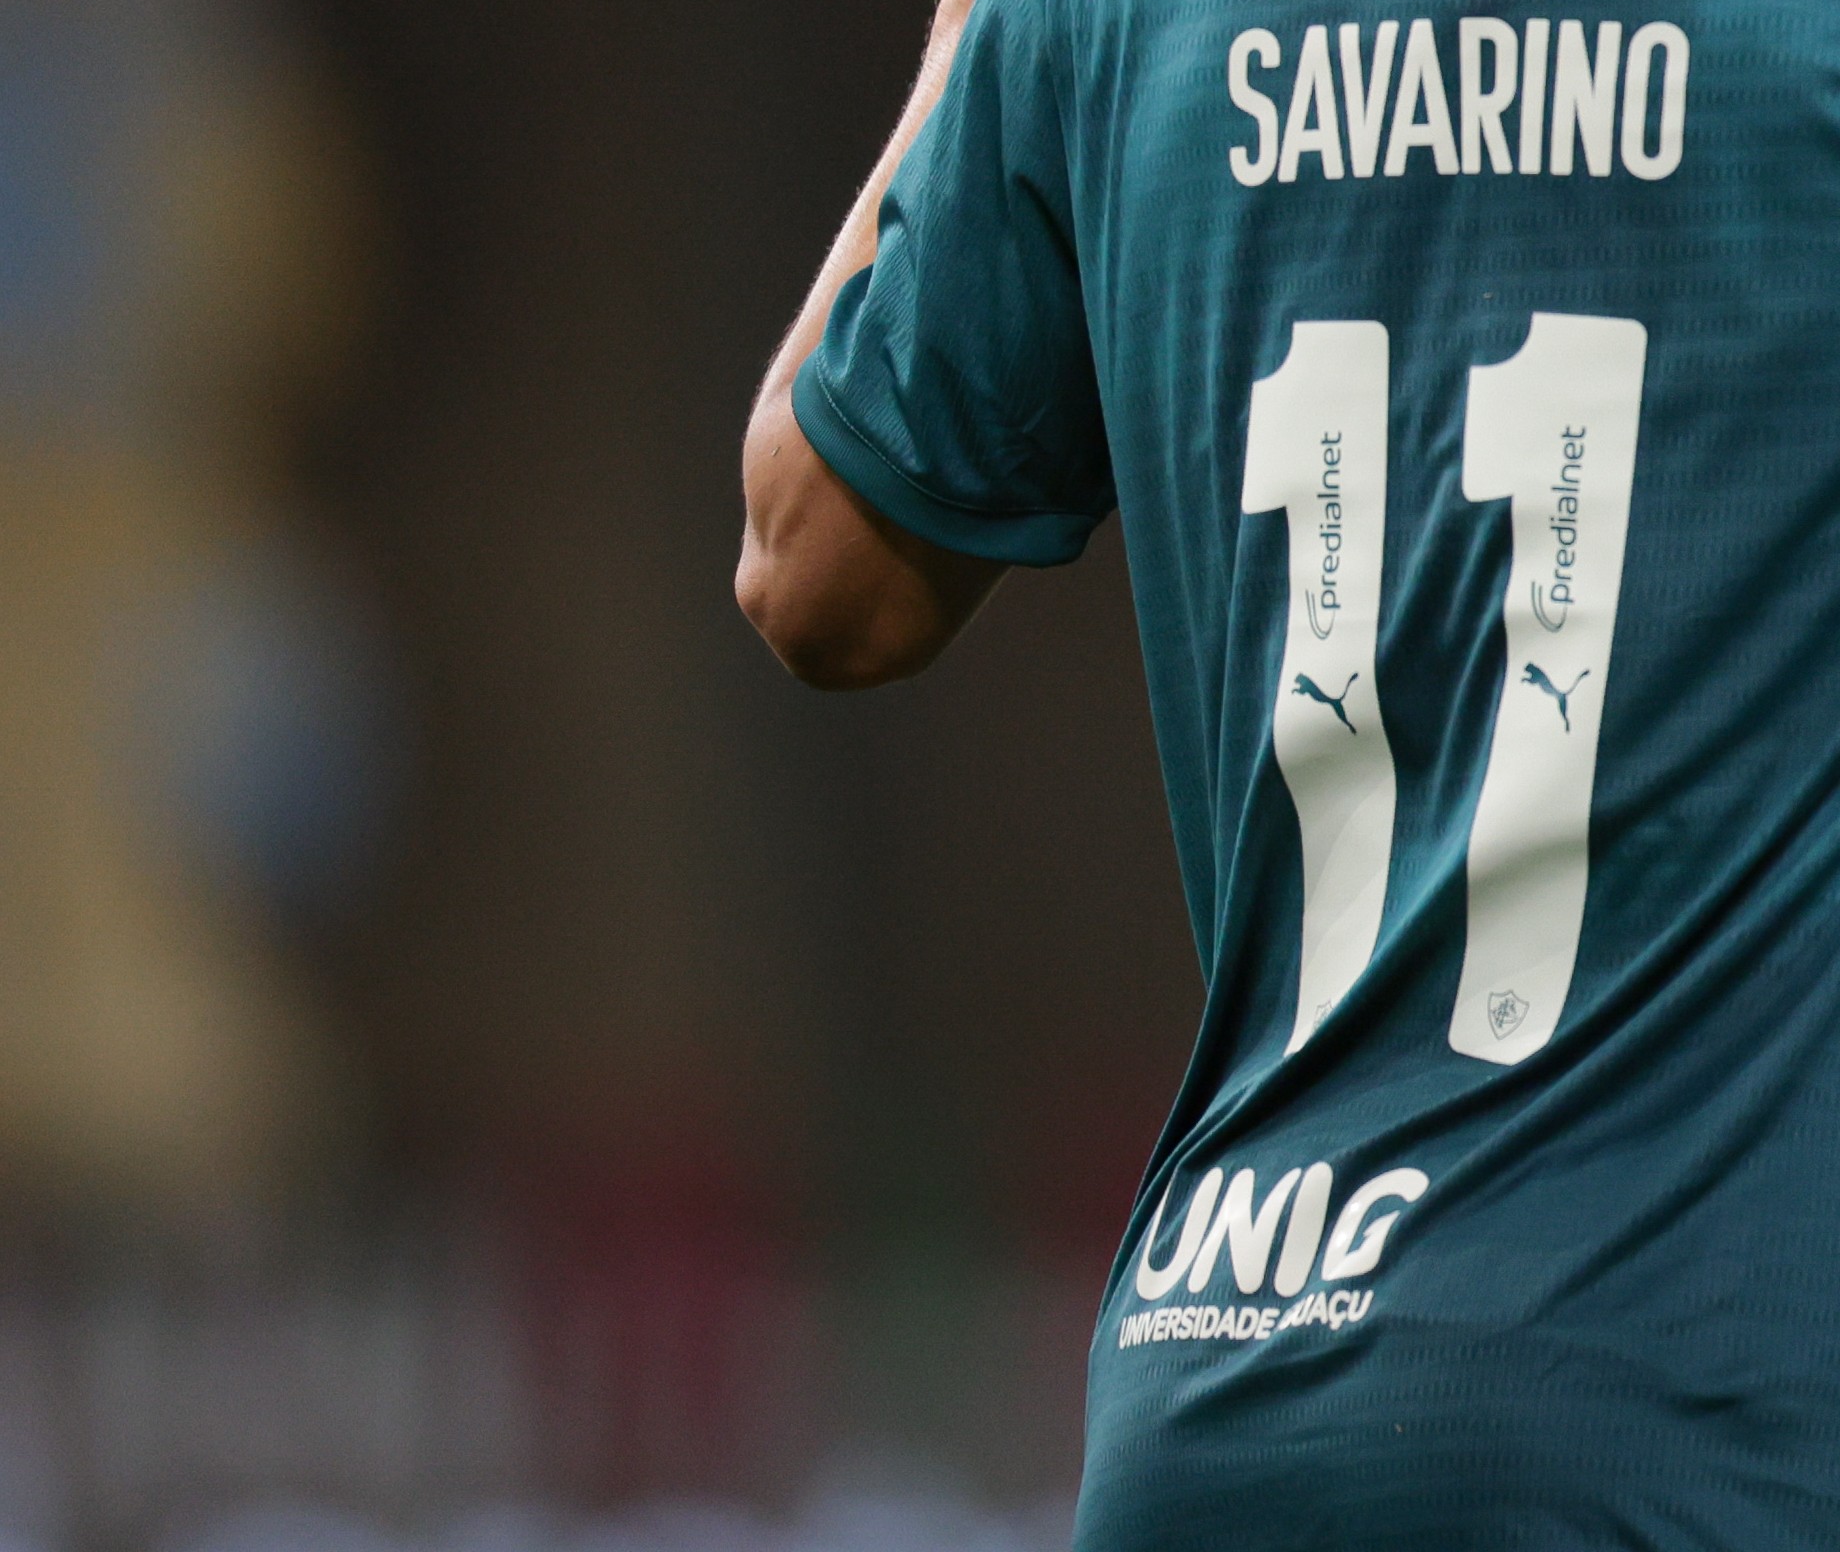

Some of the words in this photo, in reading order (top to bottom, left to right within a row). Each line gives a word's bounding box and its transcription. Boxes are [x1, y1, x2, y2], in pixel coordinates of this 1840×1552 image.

[1227, 16, 1691, 188] SAVARINO
[1316, 429, 1342, 611] predialnet
[1549, 424, 1587, 606] predialnet
[1241, 311, 1648, 1066] 11
[1135, 1160, 1430, 1301] UNIG
[1118, 1304, 1281, 1350] UNIVERSIDADE
